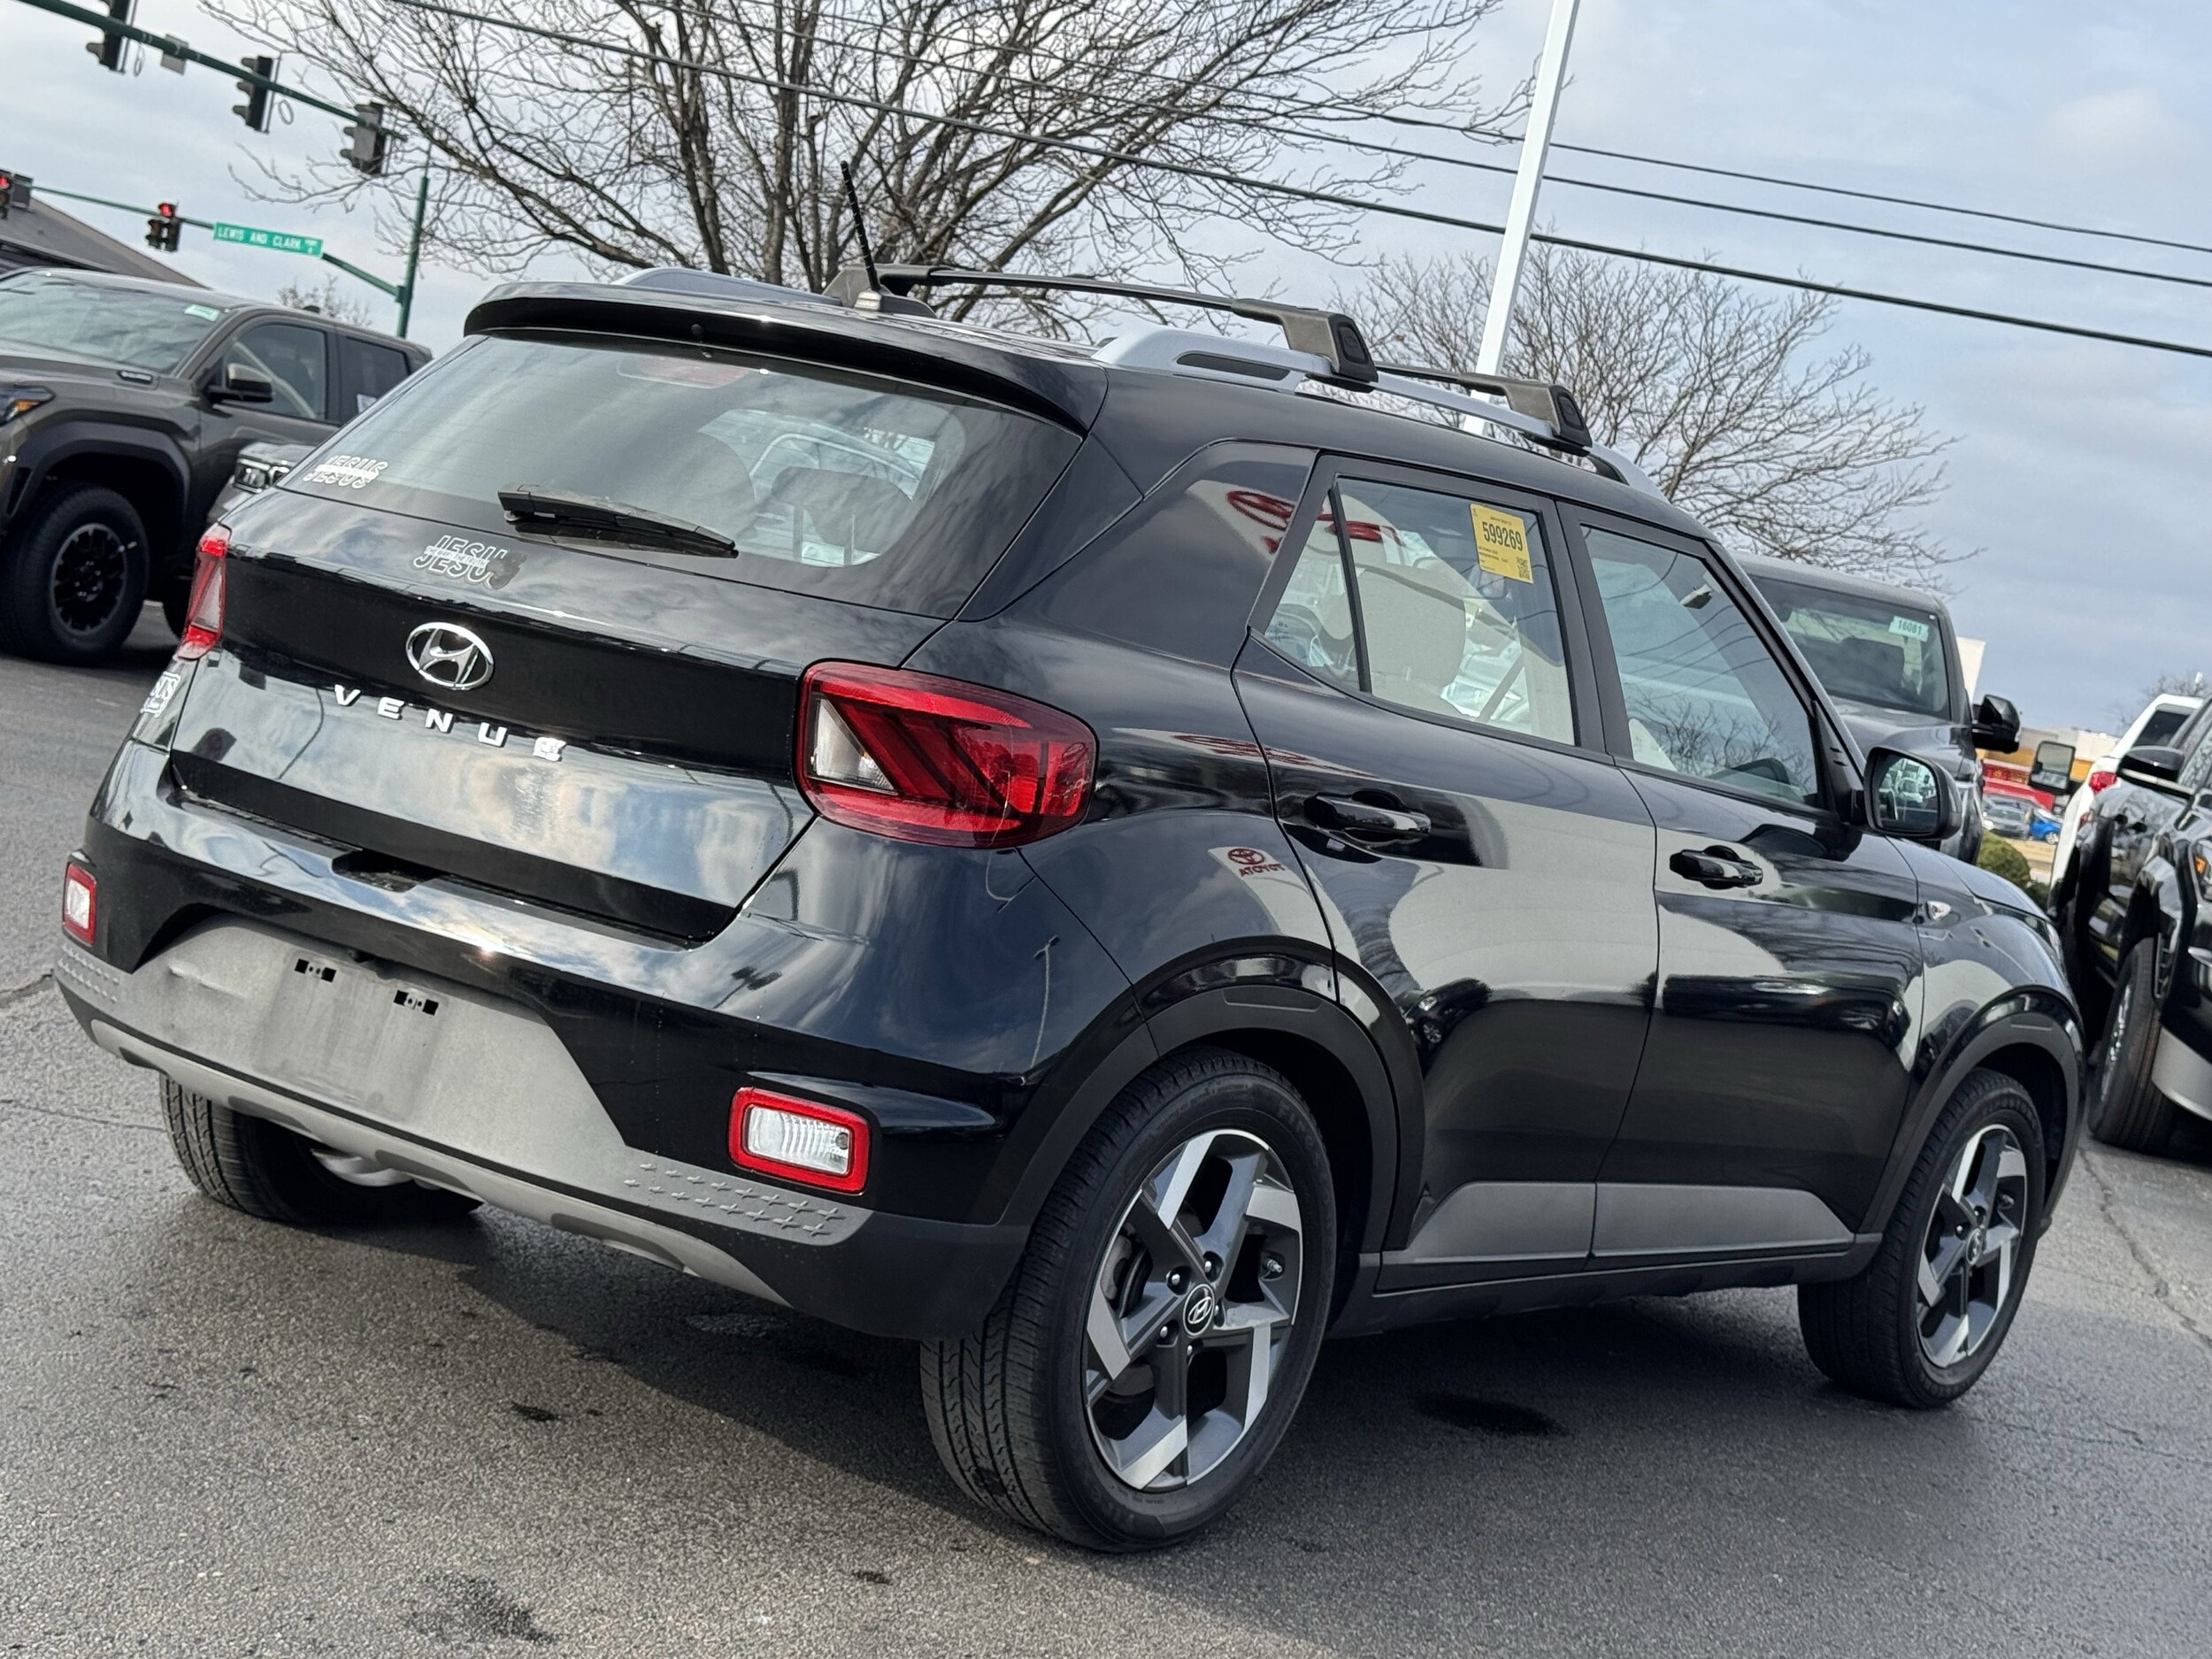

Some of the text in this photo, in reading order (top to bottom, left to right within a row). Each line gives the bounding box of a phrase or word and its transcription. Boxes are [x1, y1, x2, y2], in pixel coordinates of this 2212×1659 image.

[218, 227, 244, 241] LEWIS
[250, 232, 267, 245] AND
[273, 235, 302, 250] CLARK
[1482, 521, 1524, 551] 599269
[334, 684, 567, 762] VENUE
